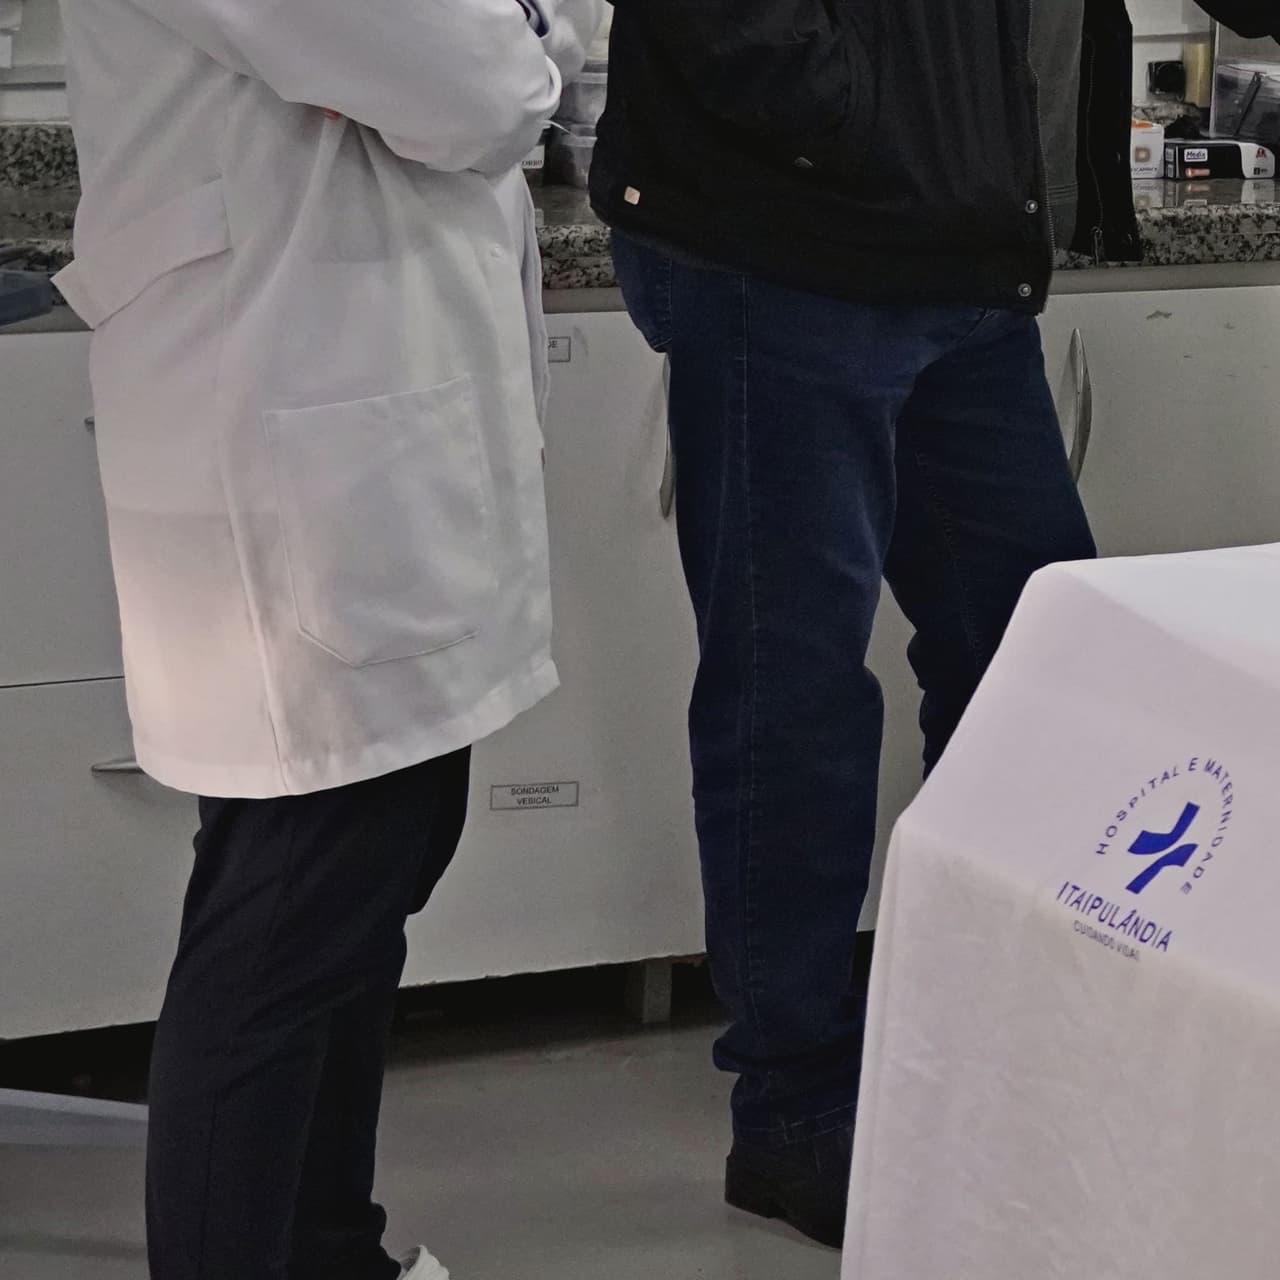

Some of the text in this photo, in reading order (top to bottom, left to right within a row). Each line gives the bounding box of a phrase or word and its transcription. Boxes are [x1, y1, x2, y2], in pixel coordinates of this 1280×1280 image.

[1187, 757, 1199, 772] E
[510, 785, 560, 797] SONDAGEM
[1055, 880, 1173, 953] ITAIPULÂNDIA
